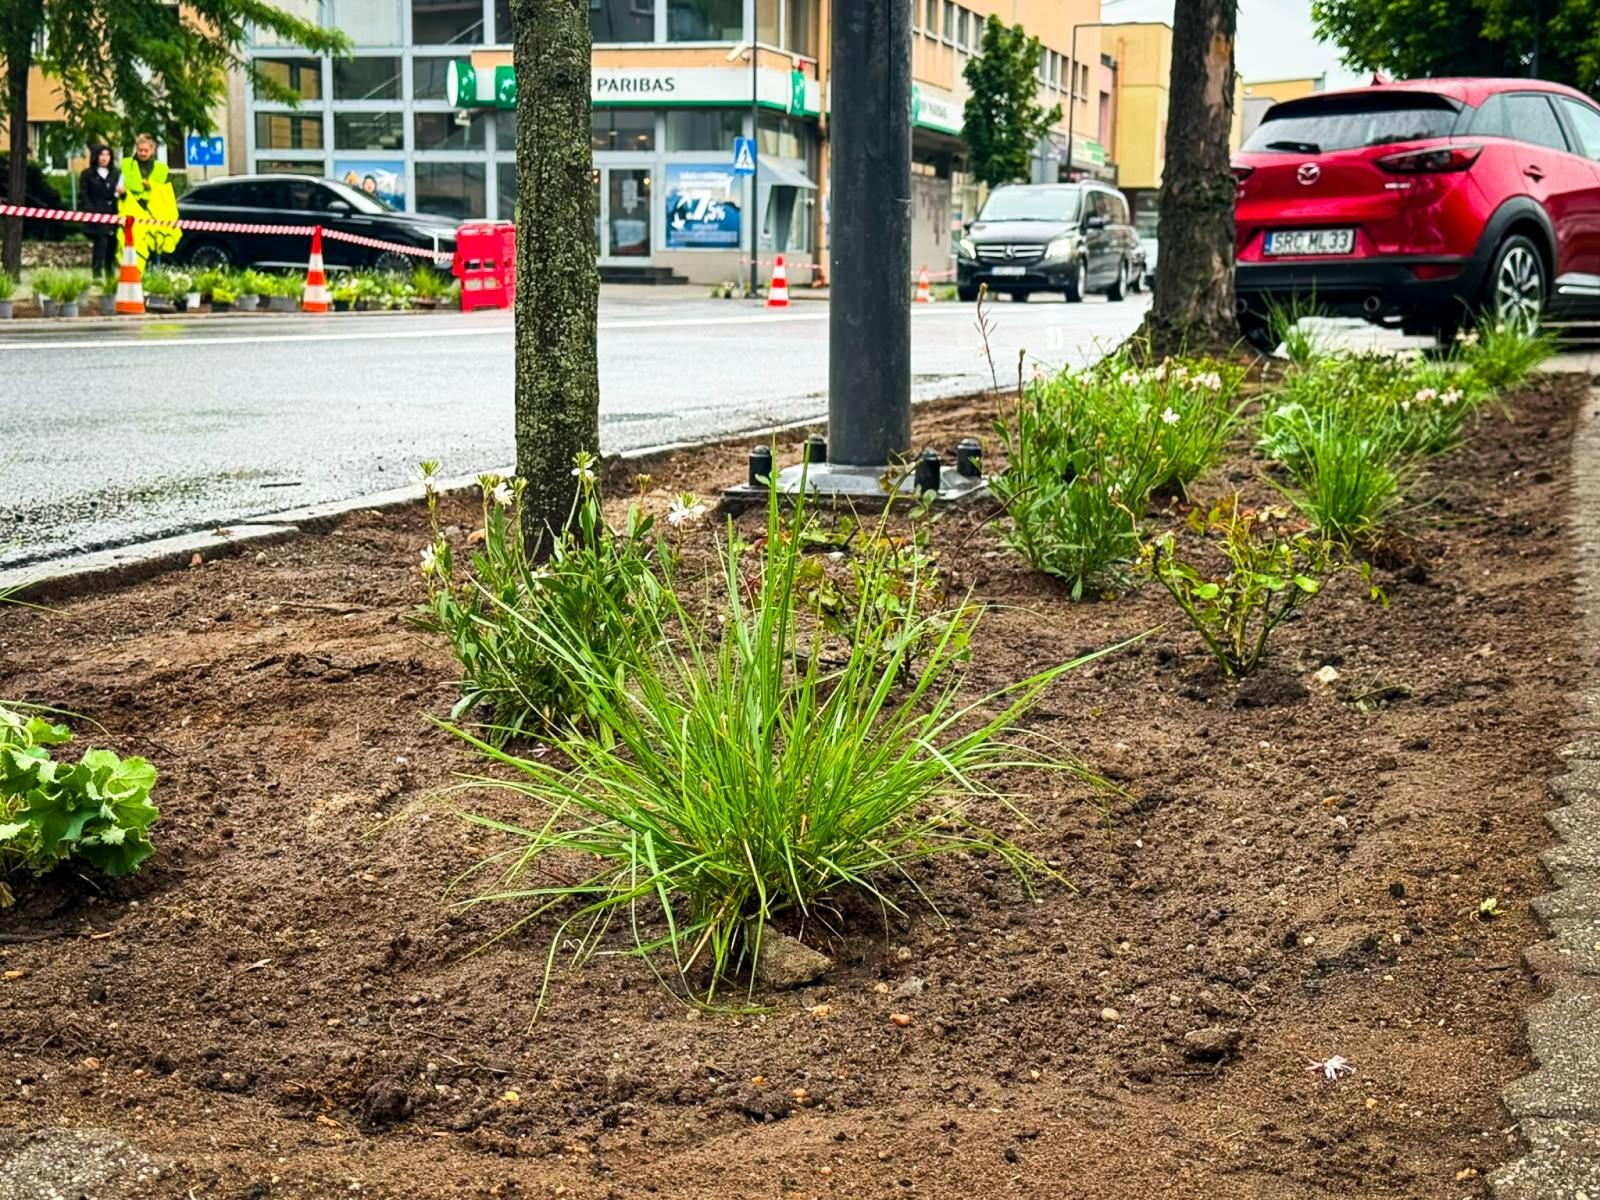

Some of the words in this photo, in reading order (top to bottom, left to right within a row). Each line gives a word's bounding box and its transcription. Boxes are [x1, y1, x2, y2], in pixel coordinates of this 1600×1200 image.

[597, 77, 675, 92] PARIBAS
[1274, 232, 1303, 251] SRC
[1308, 231, 1349, 250] ML33
